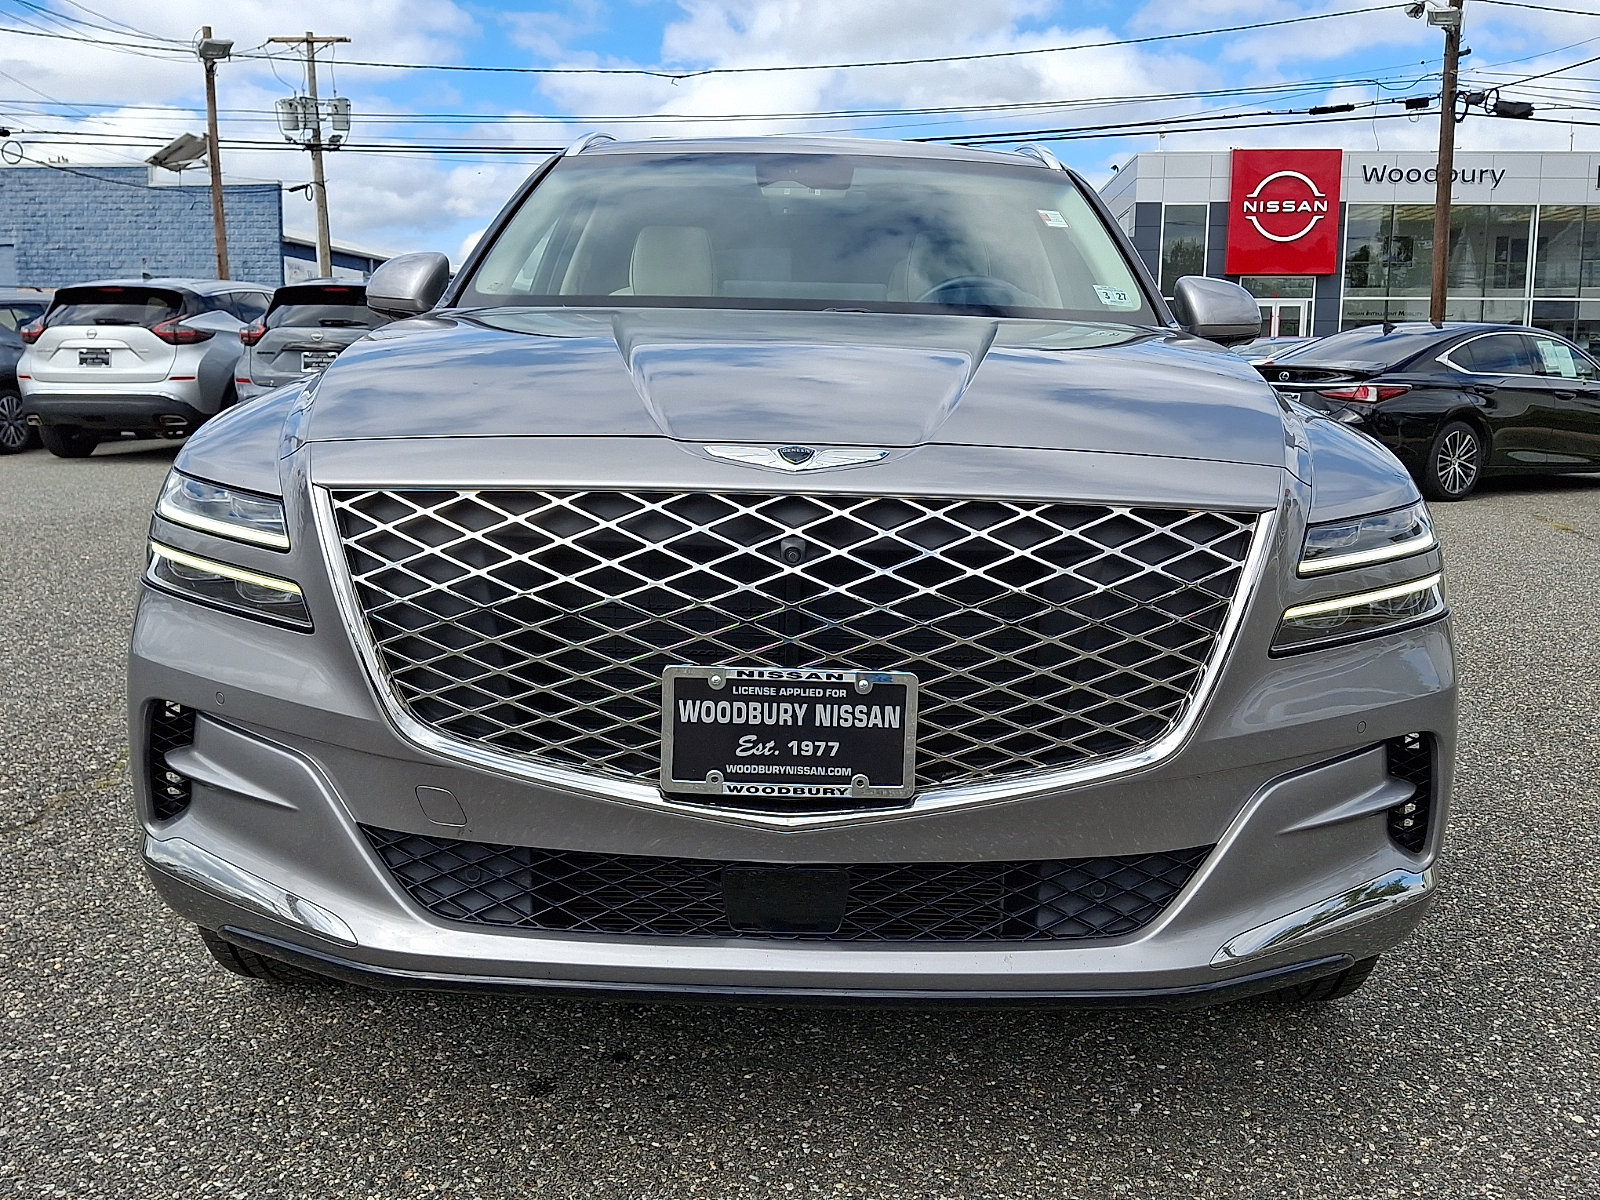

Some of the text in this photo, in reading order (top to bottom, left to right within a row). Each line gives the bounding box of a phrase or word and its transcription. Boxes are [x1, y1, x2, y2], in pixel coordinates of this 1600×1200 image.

[1243, 200, 1328, 213] NISSAN
[1115, 292, 1126, 300] 27
[736, 670, 844, 681] NISSAN
[732, 685, 847, 698] LICENSE APPLIED FOR
[678, 700, 901, 729] WOODBURY NISSAN
[735, 734, 840, 757] Est. 1977
[725, 763, 852, 777] WOODBURYNISSAN.COM
[726, 785, 849, 796] WOODBURY
